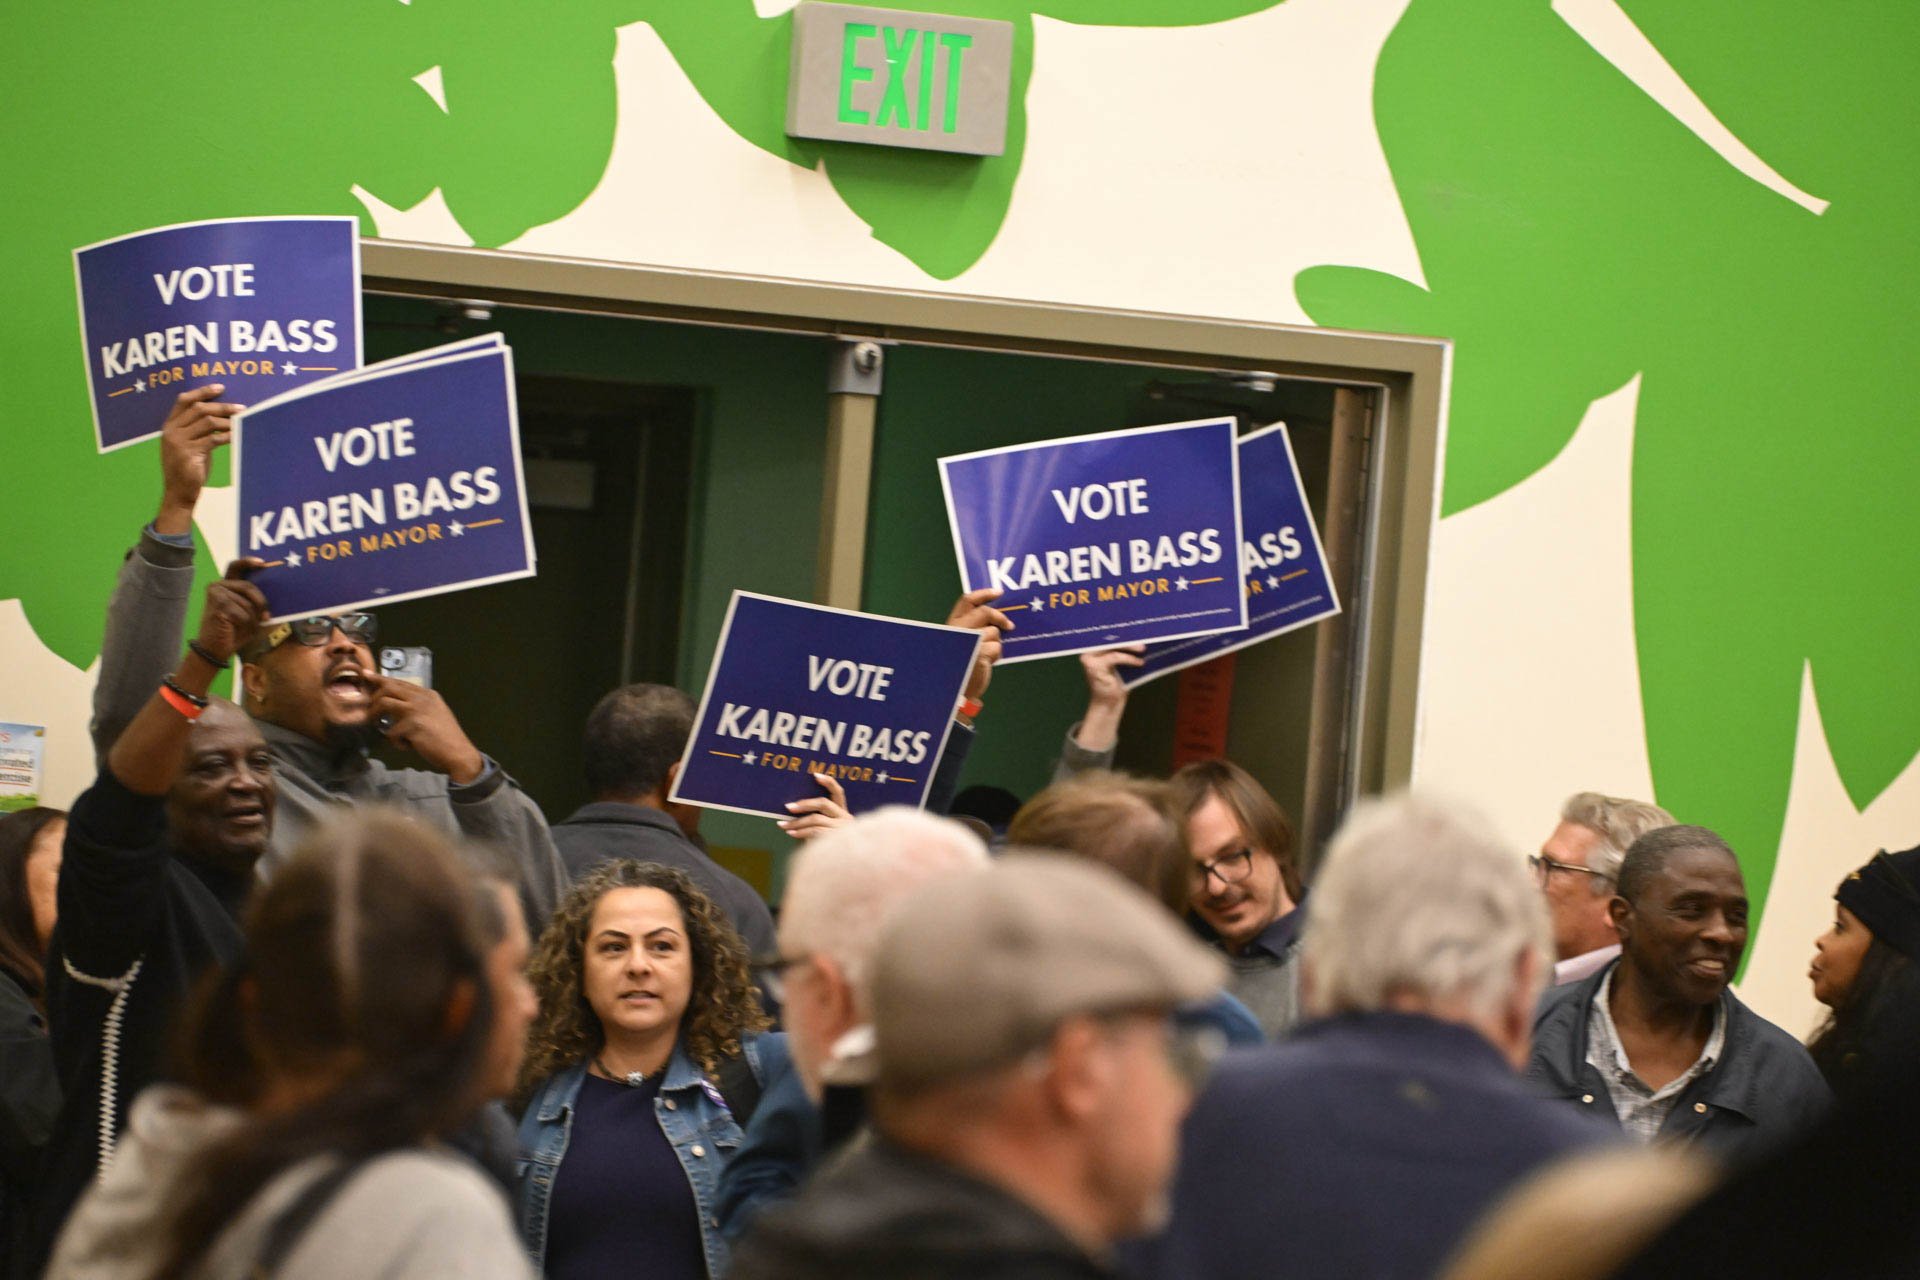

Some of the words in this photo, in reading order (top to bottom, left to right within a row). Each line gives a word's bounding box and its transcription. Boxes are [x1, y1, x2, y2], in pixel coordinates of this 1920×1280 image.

[837, 22, 973, 133] EXIT
[153, 263, 256, 306] VOTE
[101, 321, 220, 379] KAREN
[229, 319, 339, 353] BASS
[148, 367, 185, 388] FOR
[191, 360, 275, 378] MAYOR
[314, 417, 417, 473] VOTE
[249, 488, 386, 551] KAREN
[393, 466, 502, 521] BASS
[1051, 478, 1150, 525] VOTE
[305, 540, 354, 564] FOR
[359, 523, 444, 553] MAYOR
[986, 542, 1122, 592] KAREN
[1128, 528, 1223, 574] BASS
[1242, 526, 1302, 576] ASS
[1049, 589, 1091, 609] FOR
[1096, 577, 1170, 602] MAYOR
[808, 654, 895, 701] VOTE
[715, 702, 848, 755] KAREN
[846, 723, 932, 765] BASS
[760, 751, 803, 772] FOR
[806, 758, 874, 783] MAYOR
